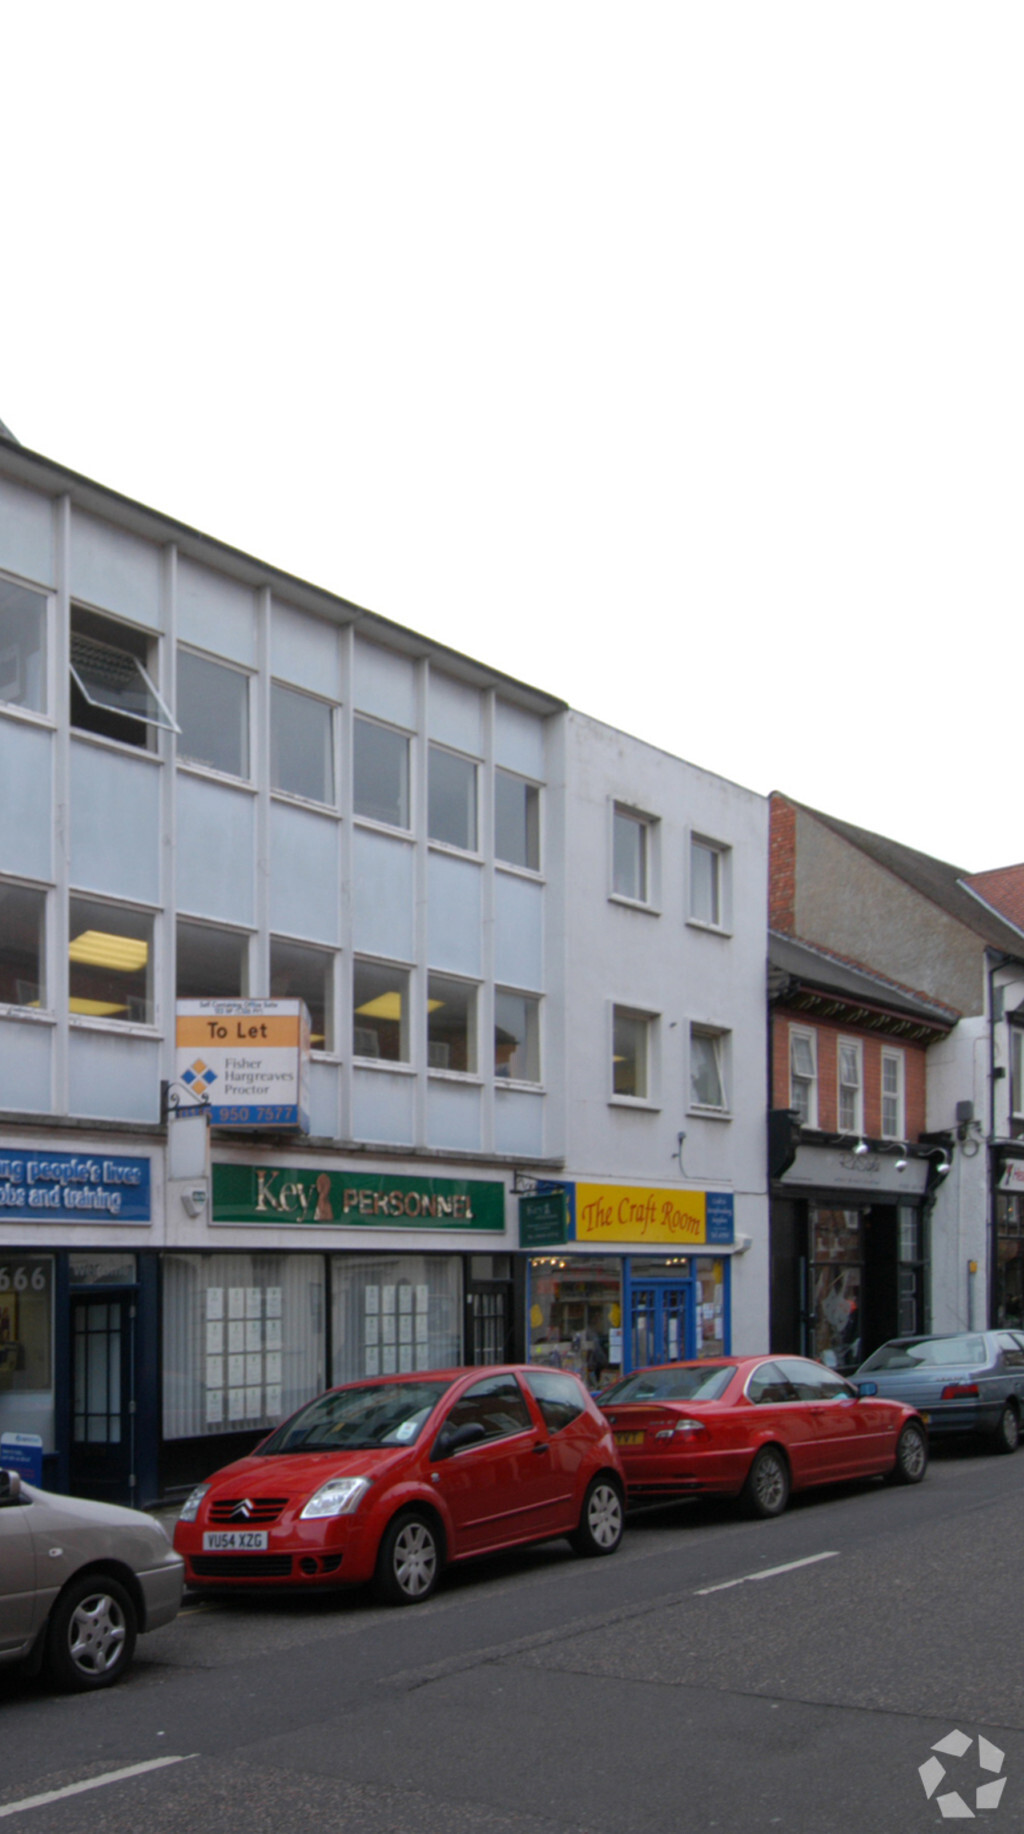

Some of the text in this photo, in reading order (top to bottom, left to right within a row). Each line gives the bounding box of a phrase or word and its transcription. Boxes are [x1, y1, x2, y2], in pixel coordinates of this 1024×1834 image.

[207, 1021, 268, 1039] To Let
[224, 1058, 262, 1070] Fisher
[224, 1071, 294, 1085] Hargreaves
[224, 1084, 270, 1095] Proctor
[218, 1107, 251, 1121] 950
[256, 1106, 293, 1120] 7577
[26, 1158, 101, 1184] people's
[103, 1160, 142, 1185] lives
[27, 1185, 61, 1207] and
[63, 1186, 122, 1214] training
[255, 1169, 475, 1222] Key PERSONNEL
[581, 1193, 700, 1236] The Craft Room
[207, 1533, 263, 1548] VU54 XZG
